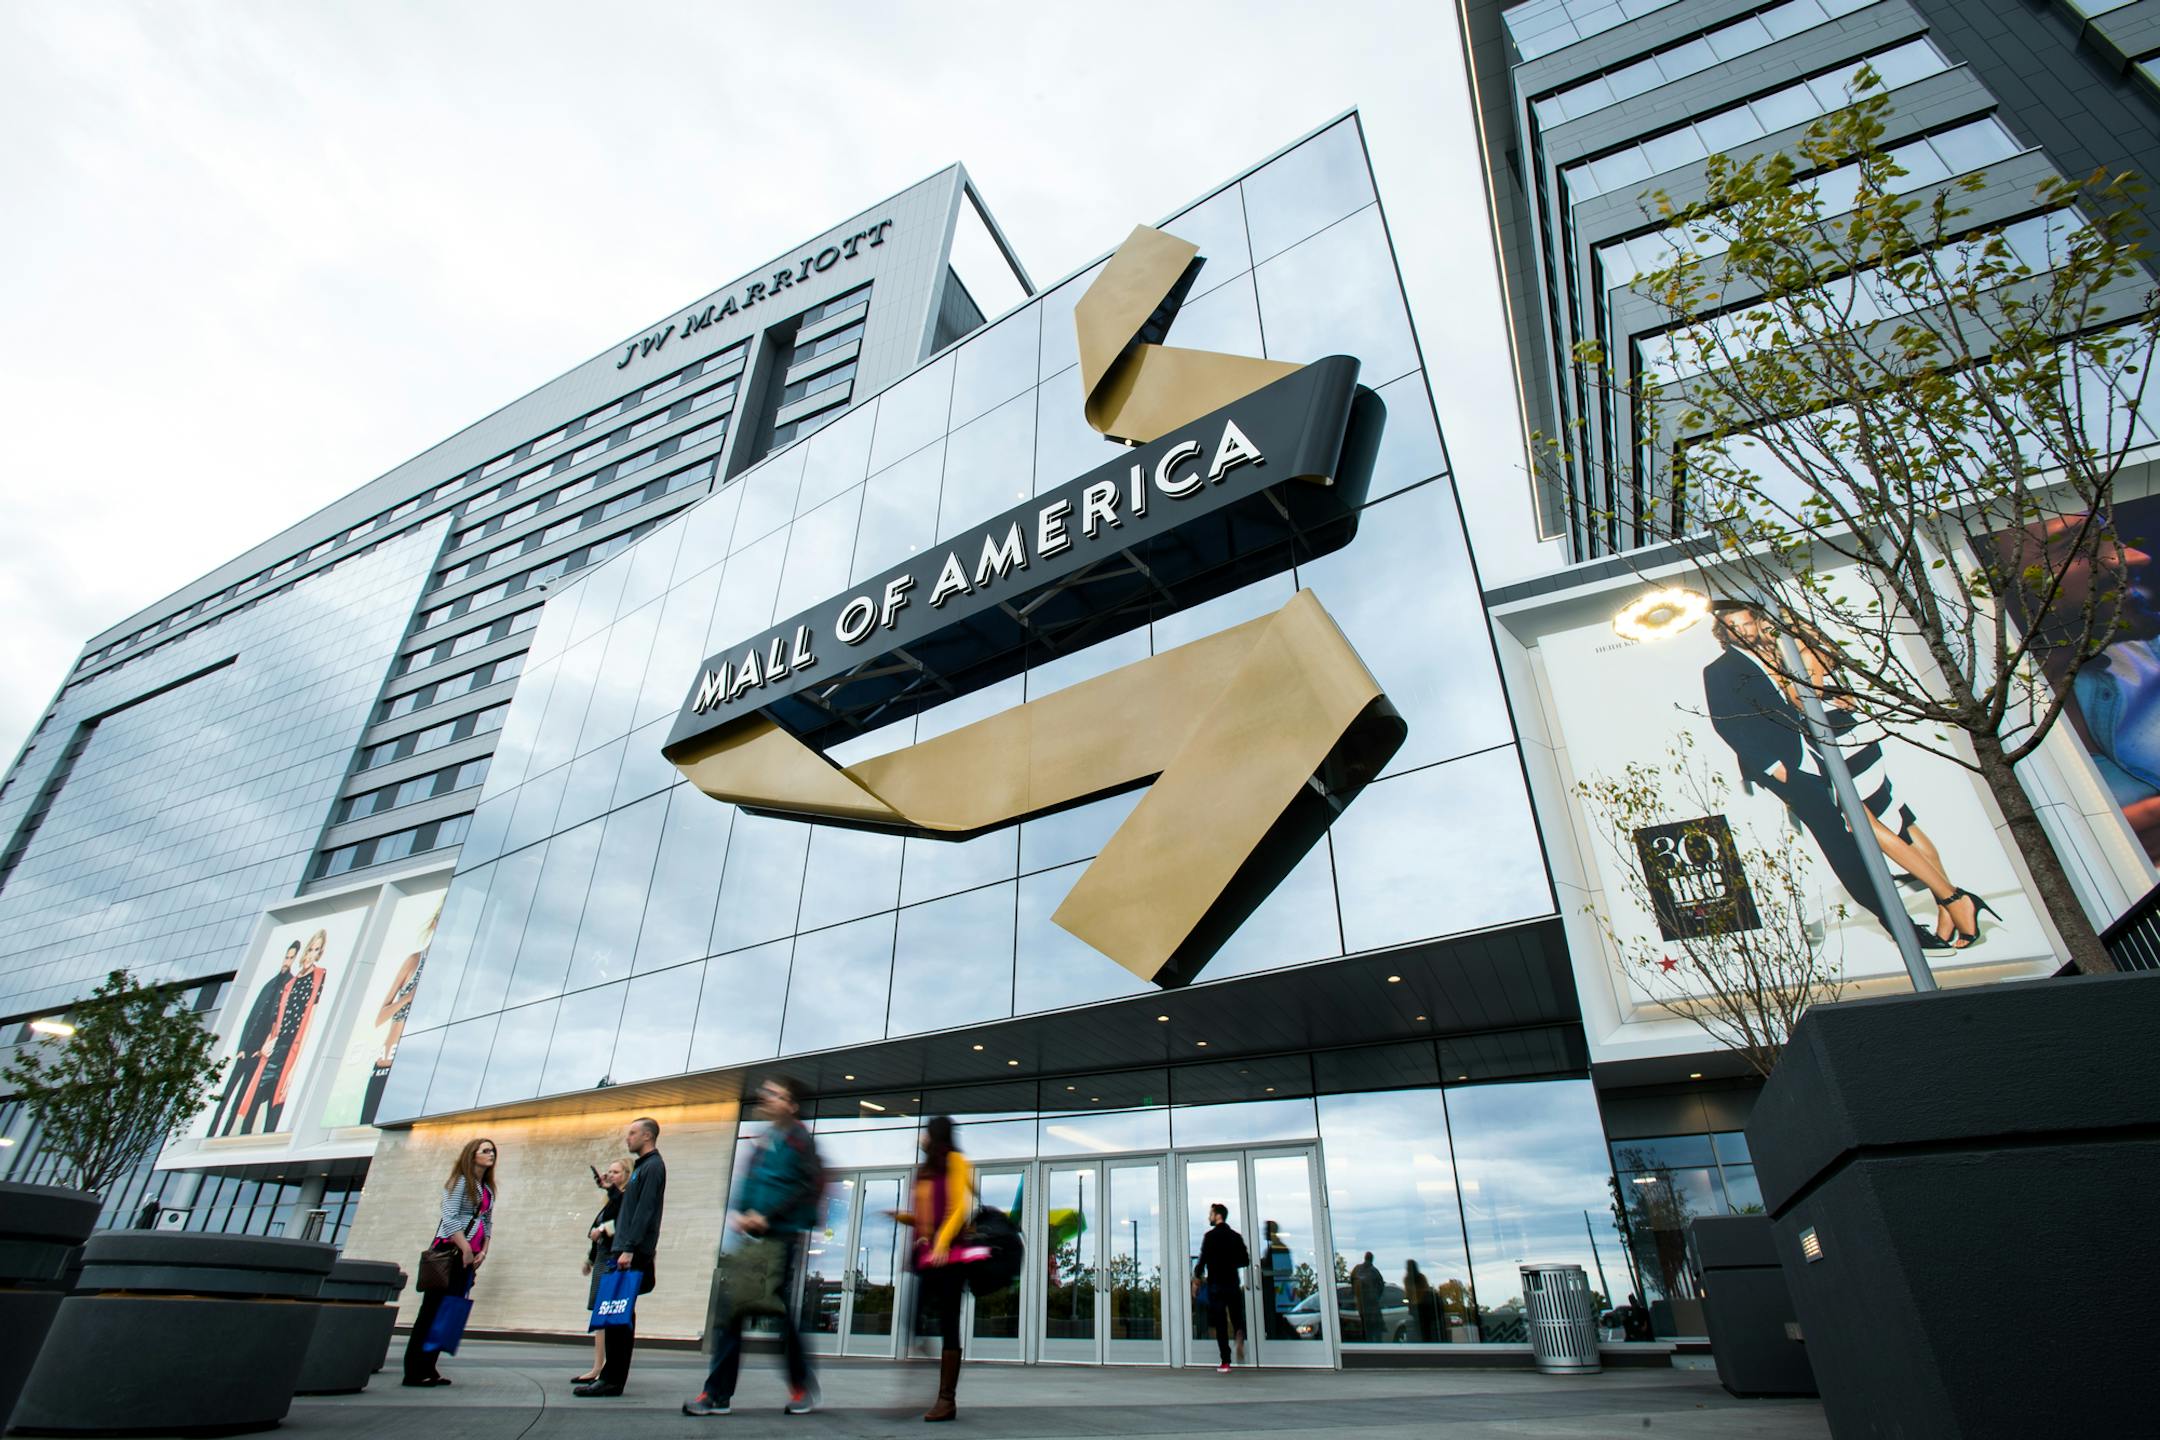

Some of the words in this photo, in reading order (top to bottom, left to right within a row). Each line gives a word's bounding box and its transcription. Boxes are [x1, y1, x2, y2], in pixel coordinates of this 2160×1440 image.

[616, 324, 676, 370] JW
[680, 218, 893, 340] MARRIOTT
[691, 624, 817, 714] MALL
[834, 573, 916, 646] OF
[929, 418, 1265, 608] AMERICA
